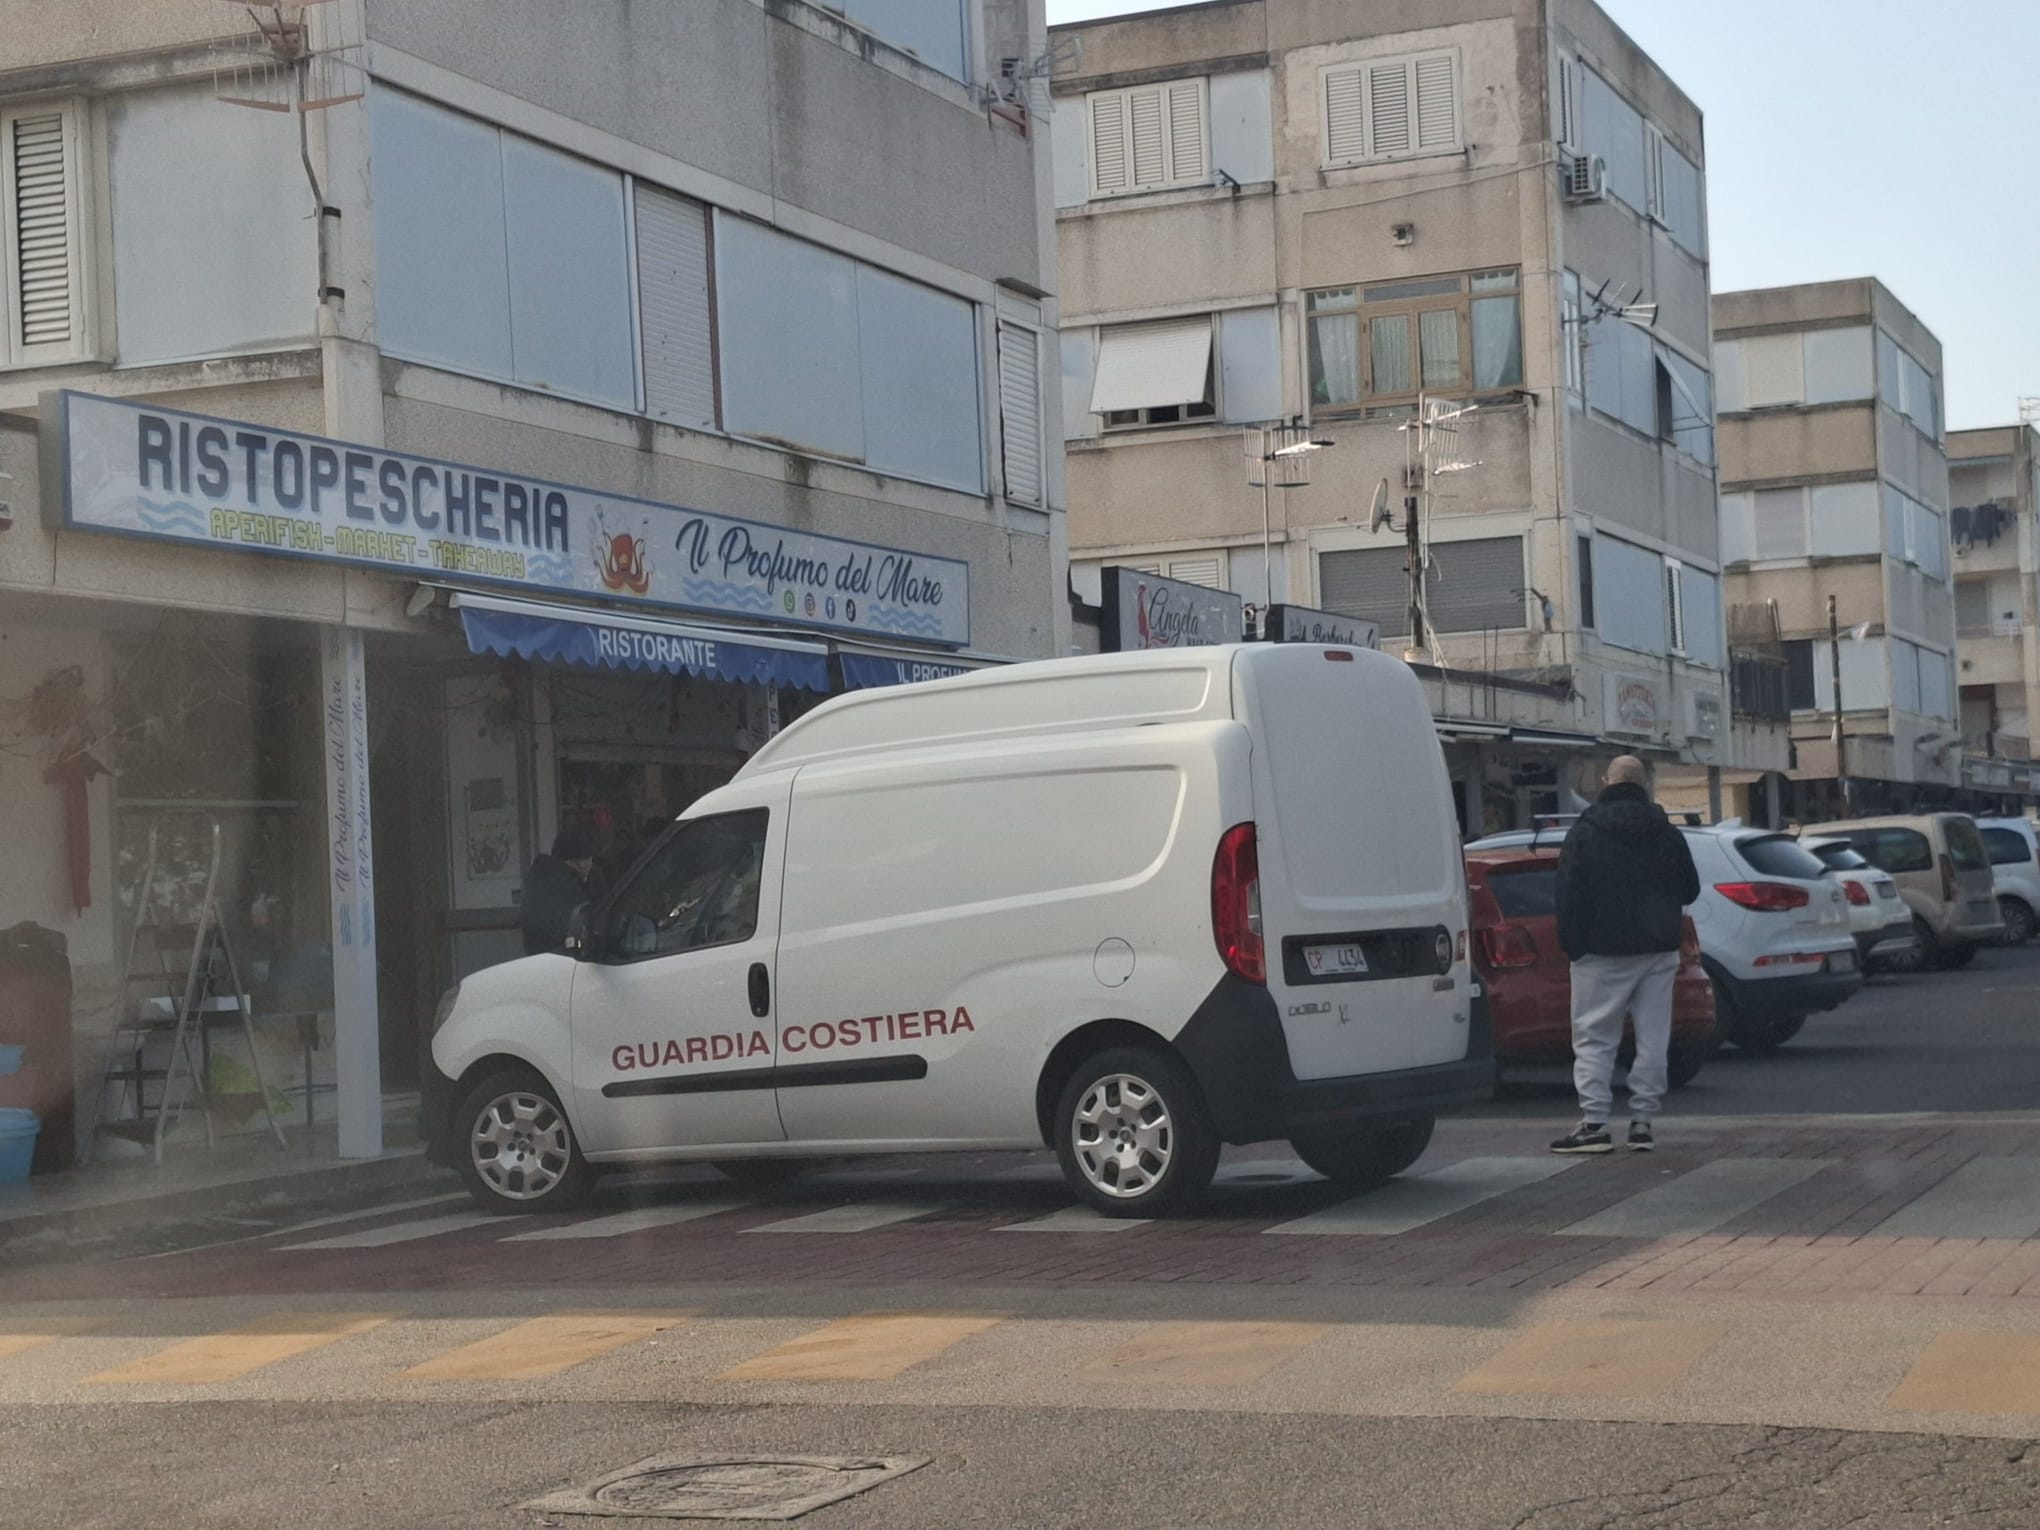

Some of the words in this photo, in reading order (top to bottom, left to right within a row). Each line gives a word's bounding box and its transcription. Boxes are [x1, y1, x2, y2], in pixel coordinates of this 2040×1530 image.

[138, 414, 569, 552] RISTOPESCHERIA
[335, 525, 416, 564] MARKET
[428, 539, 526, 579] TAKEAWAY
[675, 518, 710, 574] Il
[717, 526, 829, 595] Profumo
[835, 552, 872, 595] del
[875, 555, 943, 607] Mare
[599, 628, 716, 669] RISTORANTE
[328, 677, 345, 738] Mare
[332, 739, 345, 774] del
[333, 777, 352, 864] Profumo
[612, 1030, 770, 1071] GUARDIA
[782, 1006, 975, 1053] COSTIERA
